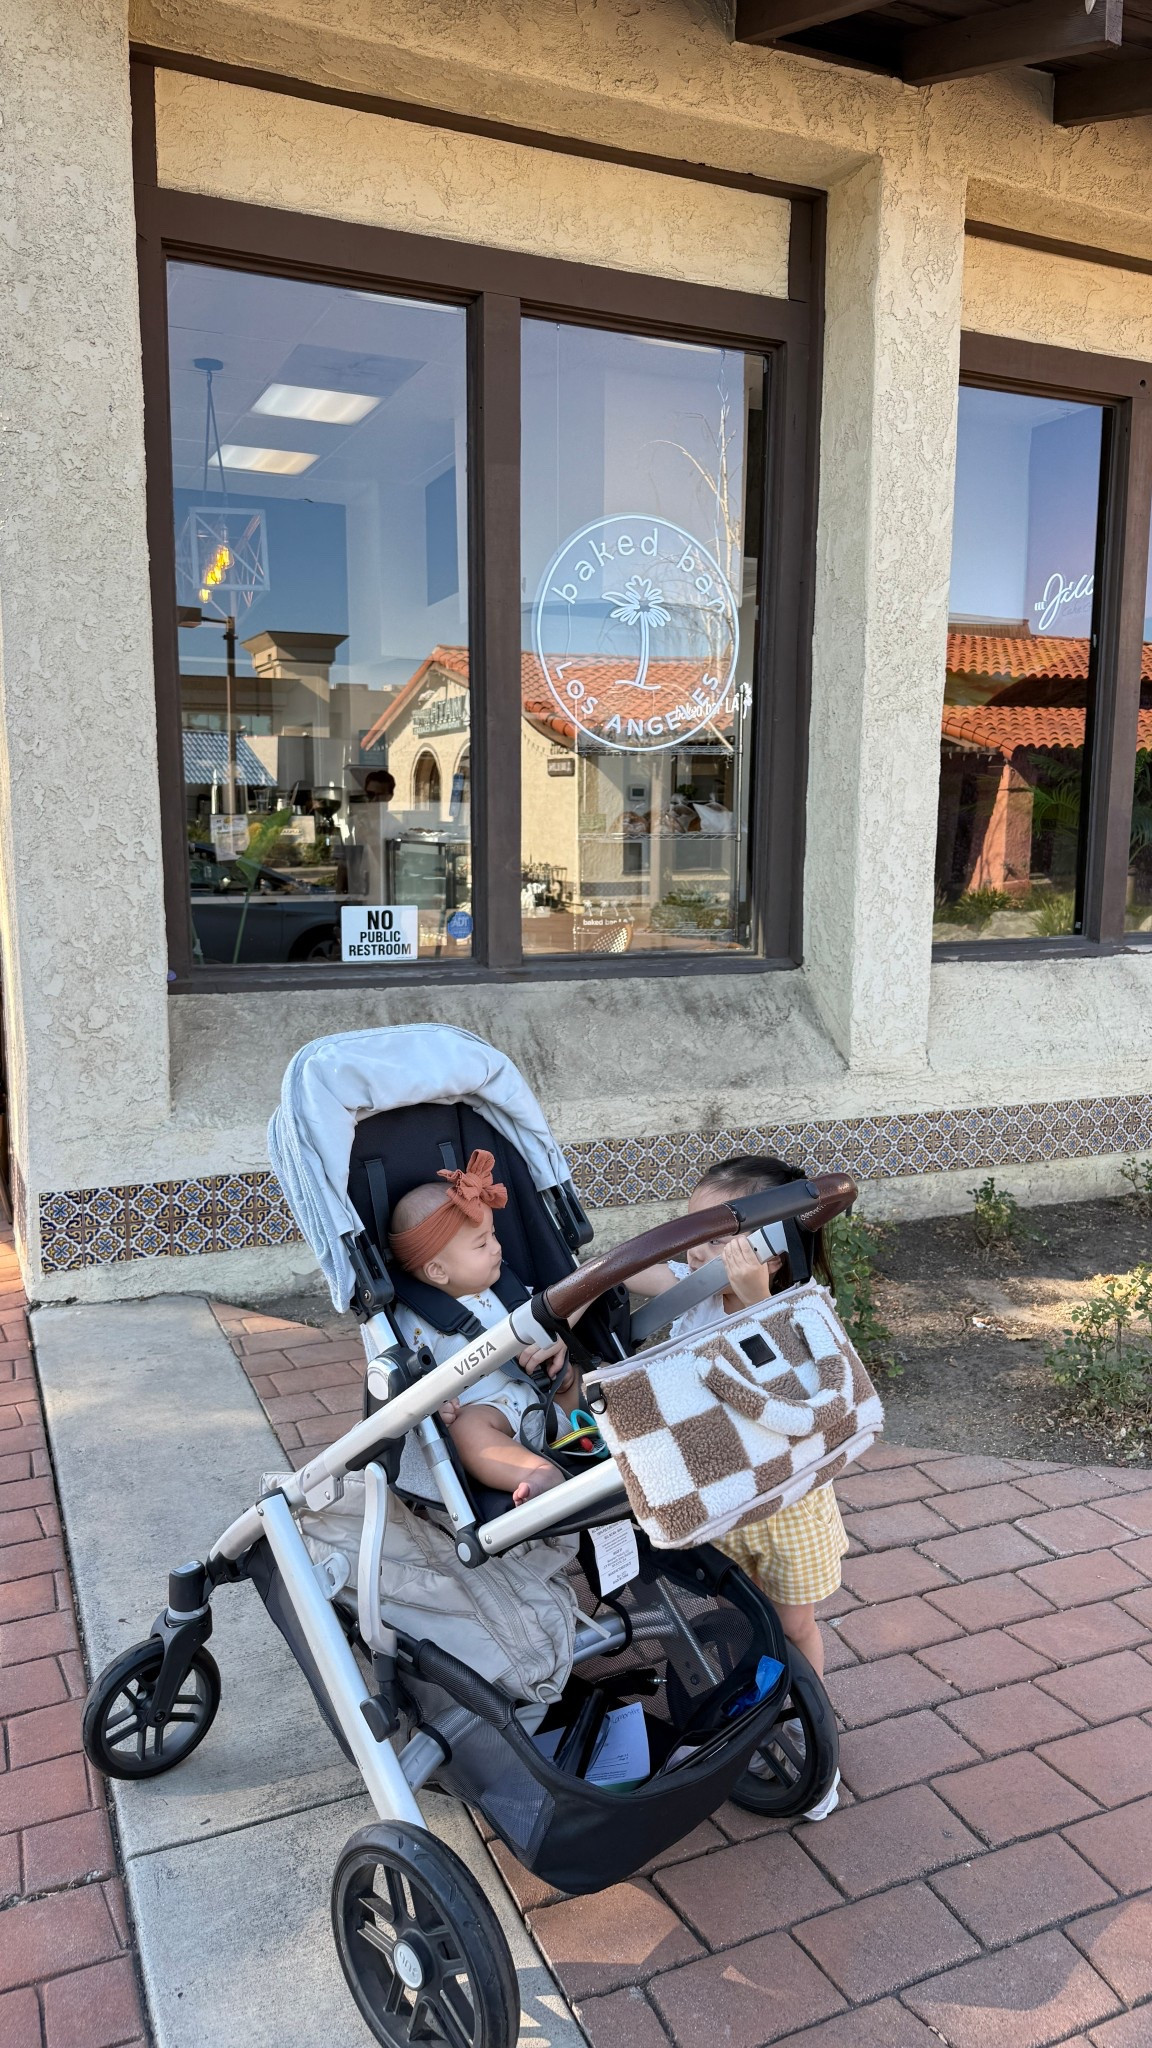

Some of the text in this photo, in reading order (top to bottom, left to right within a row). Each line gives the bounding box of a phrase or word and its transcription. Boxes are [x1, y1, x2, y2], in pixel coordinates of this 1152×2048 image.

[551, 528, 726, 614] baked bar
[555, 661, 719, 736] LOS ANGELES
[367, 910, 393, 930] NO
[451, 917, 468, 926] ADT
[582, 918, 604, 926] baked
[360, 931, 401, 943] PUBLIC
[348, 943, 412, 956] RESTROOM
[453, 1341, 497, 1376] VISTA
